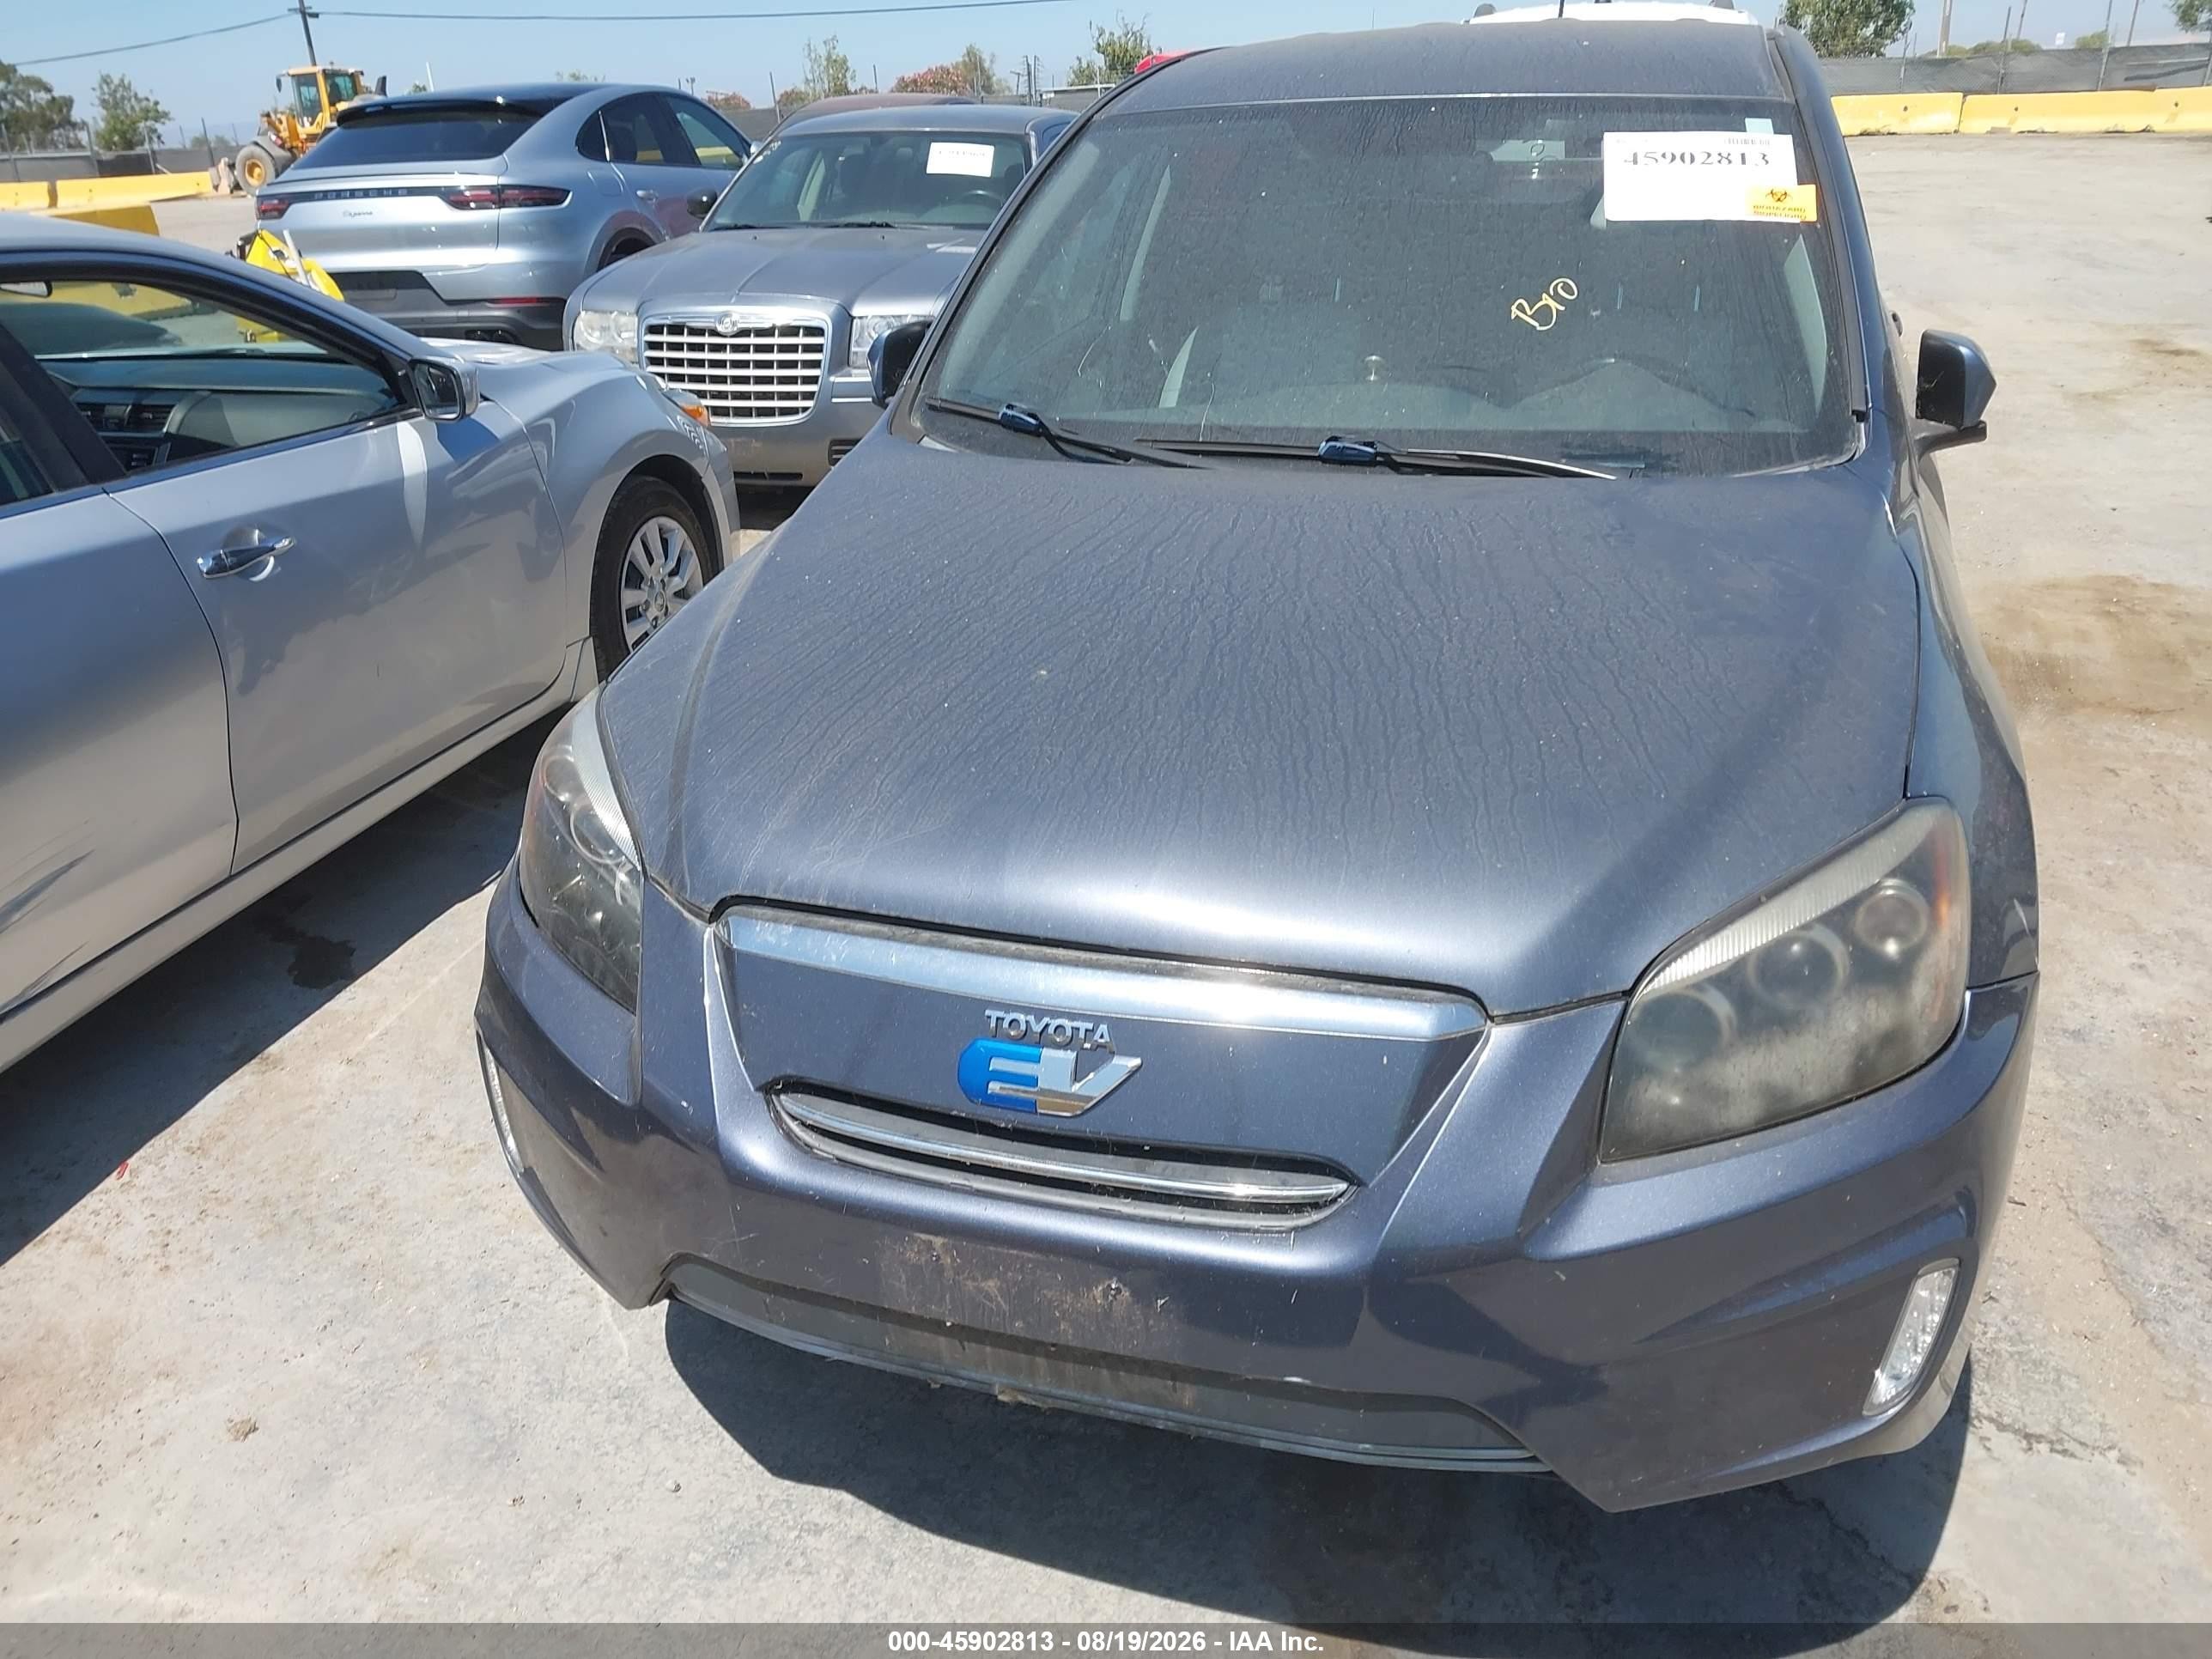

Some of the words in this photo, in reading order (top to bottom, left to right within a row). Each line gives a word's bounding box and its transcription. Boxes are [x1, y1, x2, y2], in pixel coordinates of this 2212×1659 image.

[1623, 150, 1771, 167] 45902813
[314, 188, 408, 200] PORSCHE
[984, 1008, 1115, 1054] TOYOTA
[957, 1037, 1143, 1118] EV
